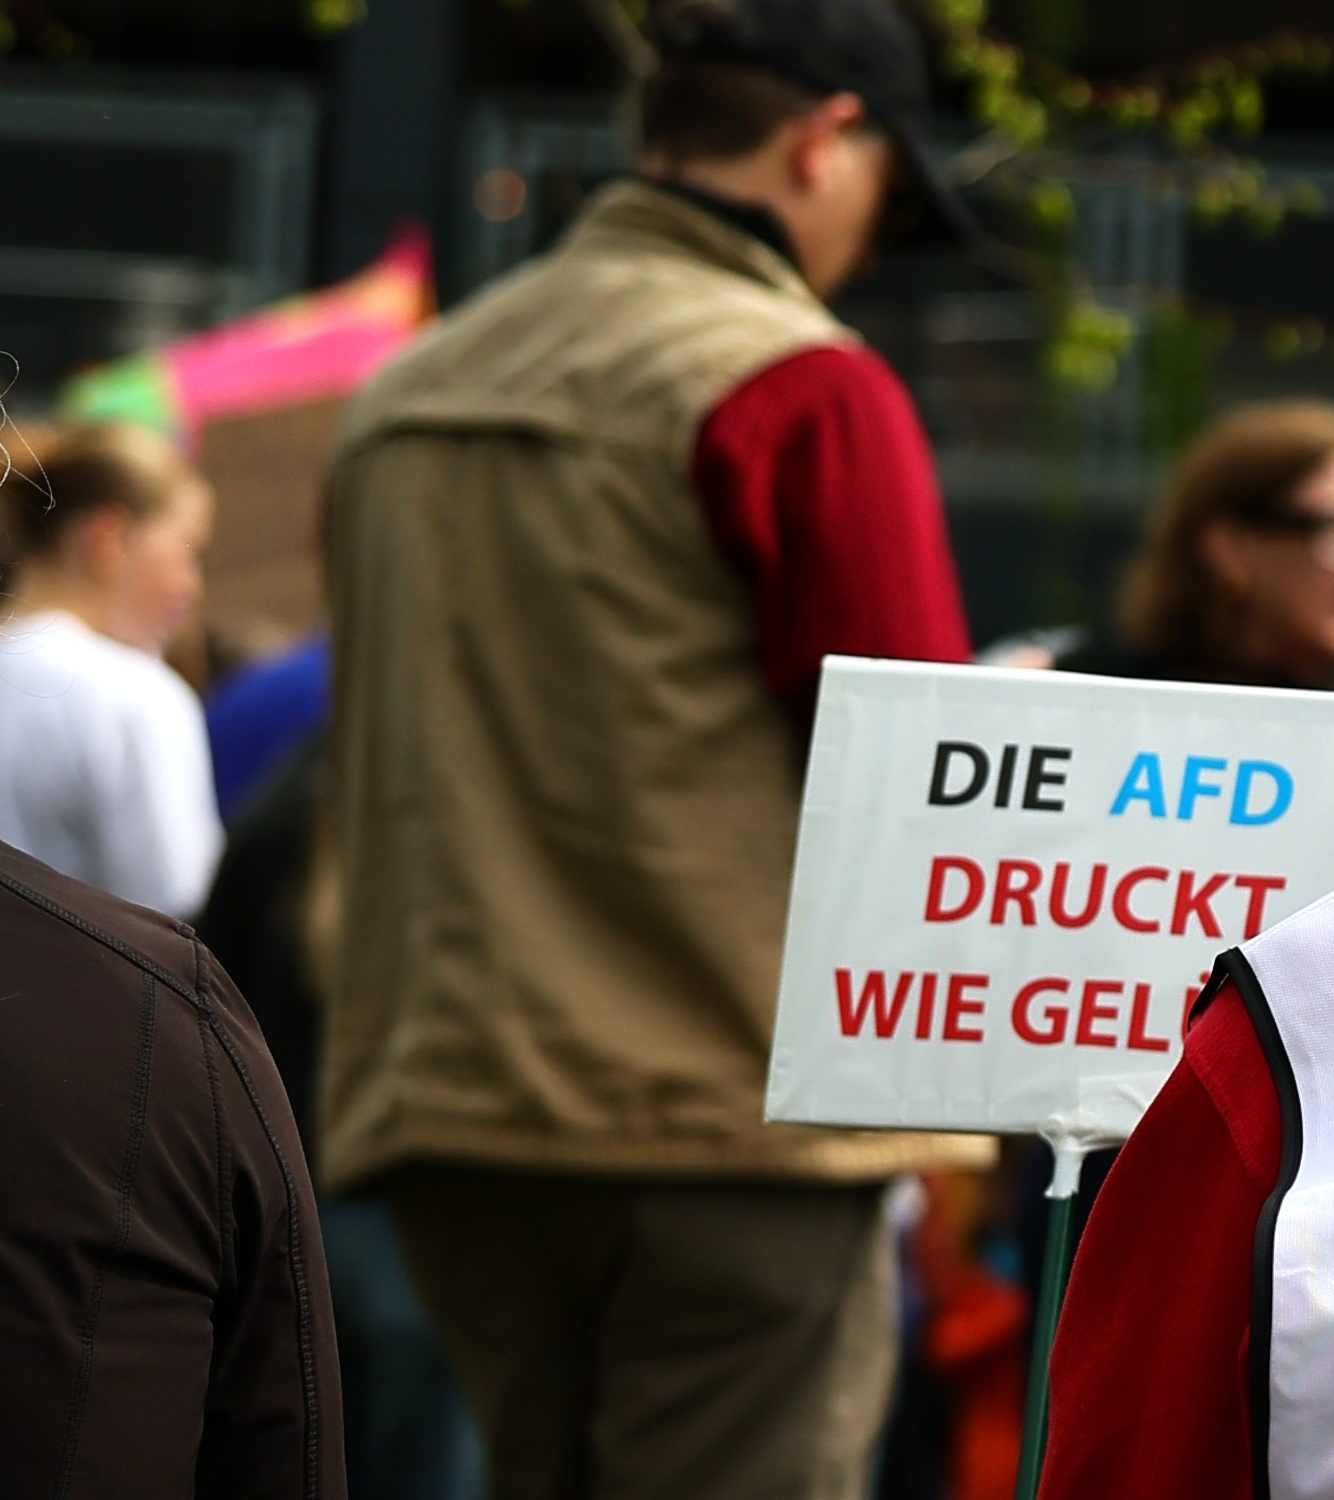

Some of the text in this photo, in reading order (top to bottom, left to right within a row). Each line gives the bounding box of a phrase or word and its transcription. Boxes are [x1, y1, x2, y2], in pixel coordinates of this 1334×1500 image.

[927, 740, 1295, 828] DIE AFD
[923, 855, 1287, 941] DRUCKT
[834, 967, 1210, 1053] WIE GEL
